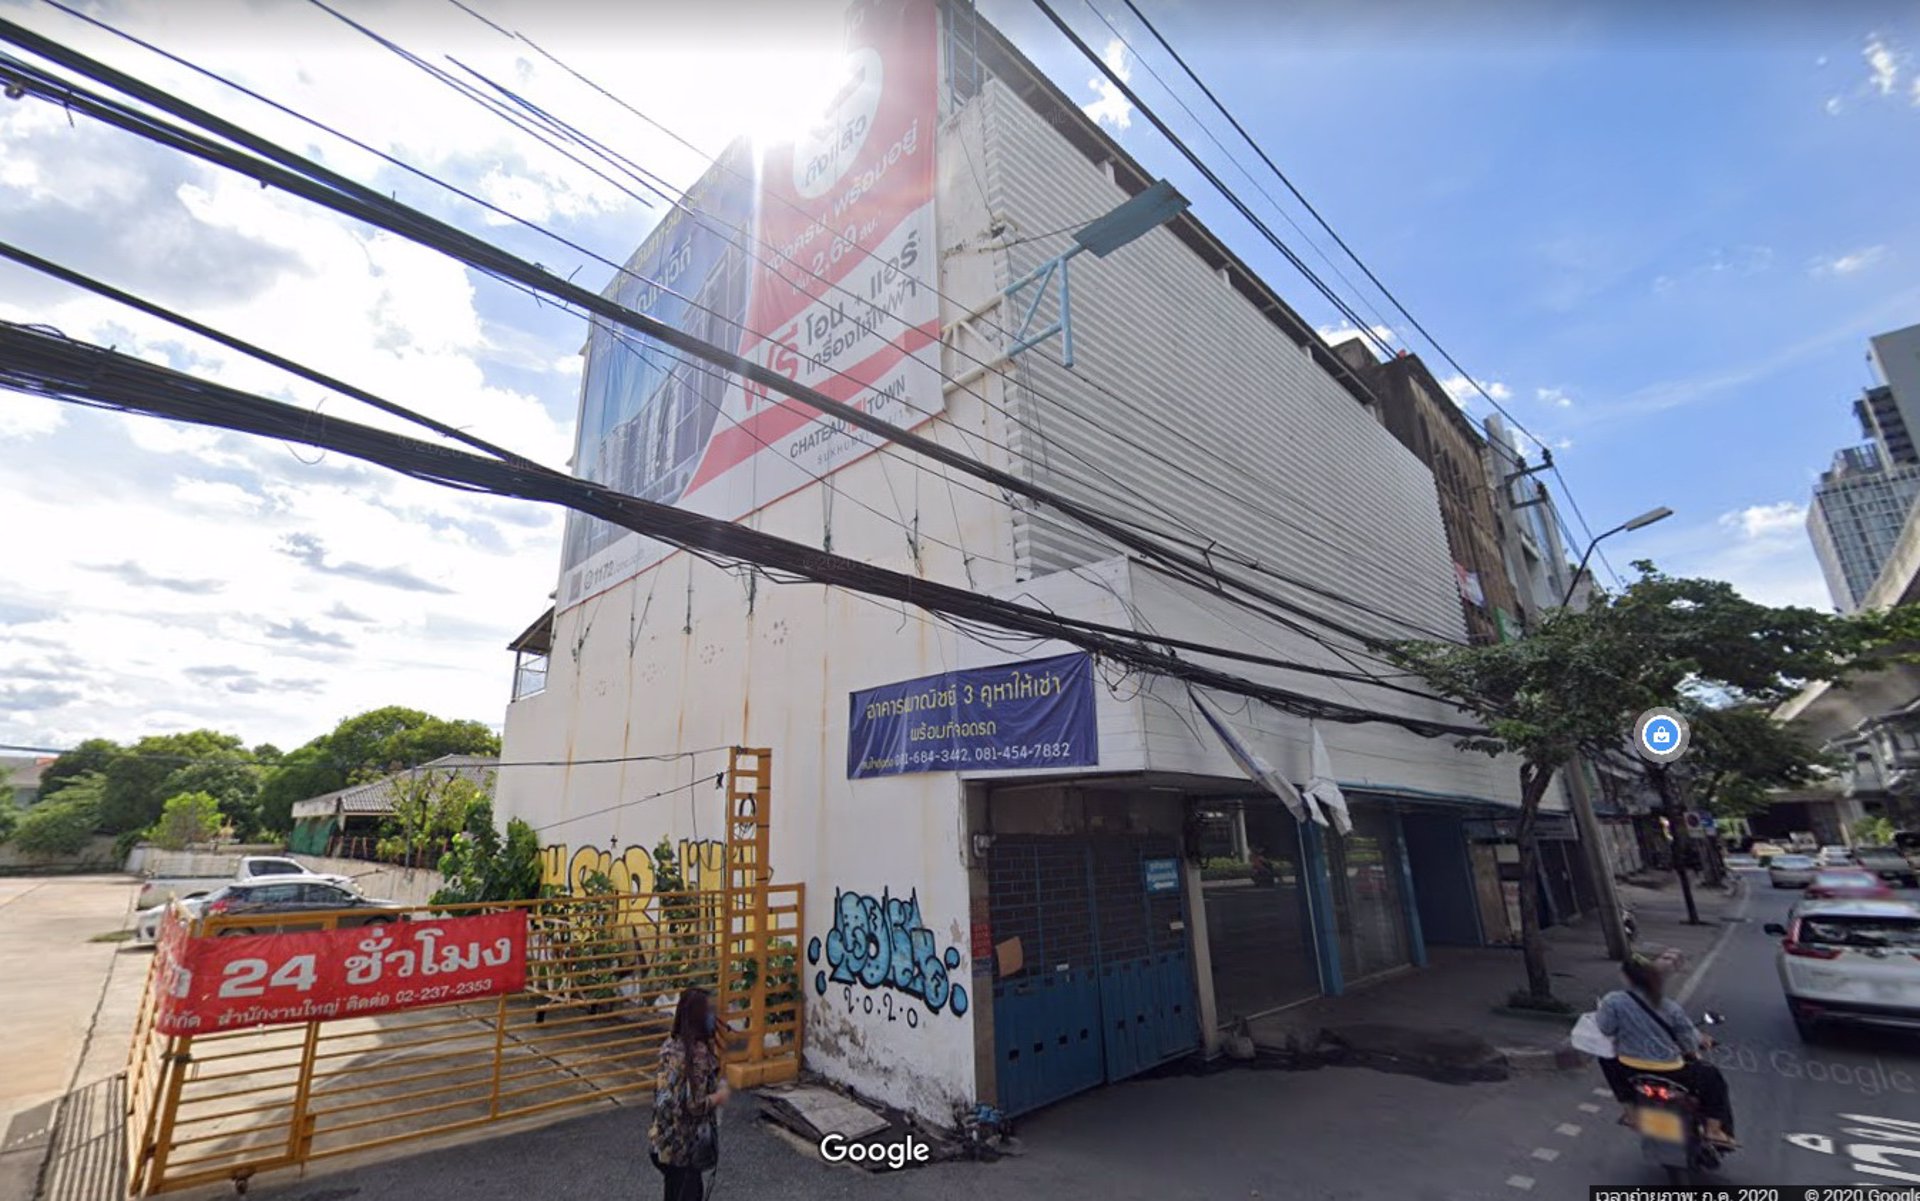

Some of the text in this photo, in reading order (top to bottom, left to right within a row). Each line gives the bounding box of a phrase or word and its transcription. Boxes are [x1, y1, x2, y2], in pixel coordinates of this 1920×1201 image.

[813, 224, 857, 277] 2.69
[806, 302, 844, 346] โอน
[870, 230, 918, 299] แอร์
[867, 374, 906, 415] TOWN
[963, 684, 974, 704] 3
[980, 671, 1062, 709] คูหาให้เช่า
[975, 742, 1071, 762] 081-454-7832
[218, 954, 318, 998] 24
[343, 928, 512, 986] ชั่วโมง
[346, 991, 389, 1012] ติดต่อ
[395, 978, 493, 1004] 02-237-2353
